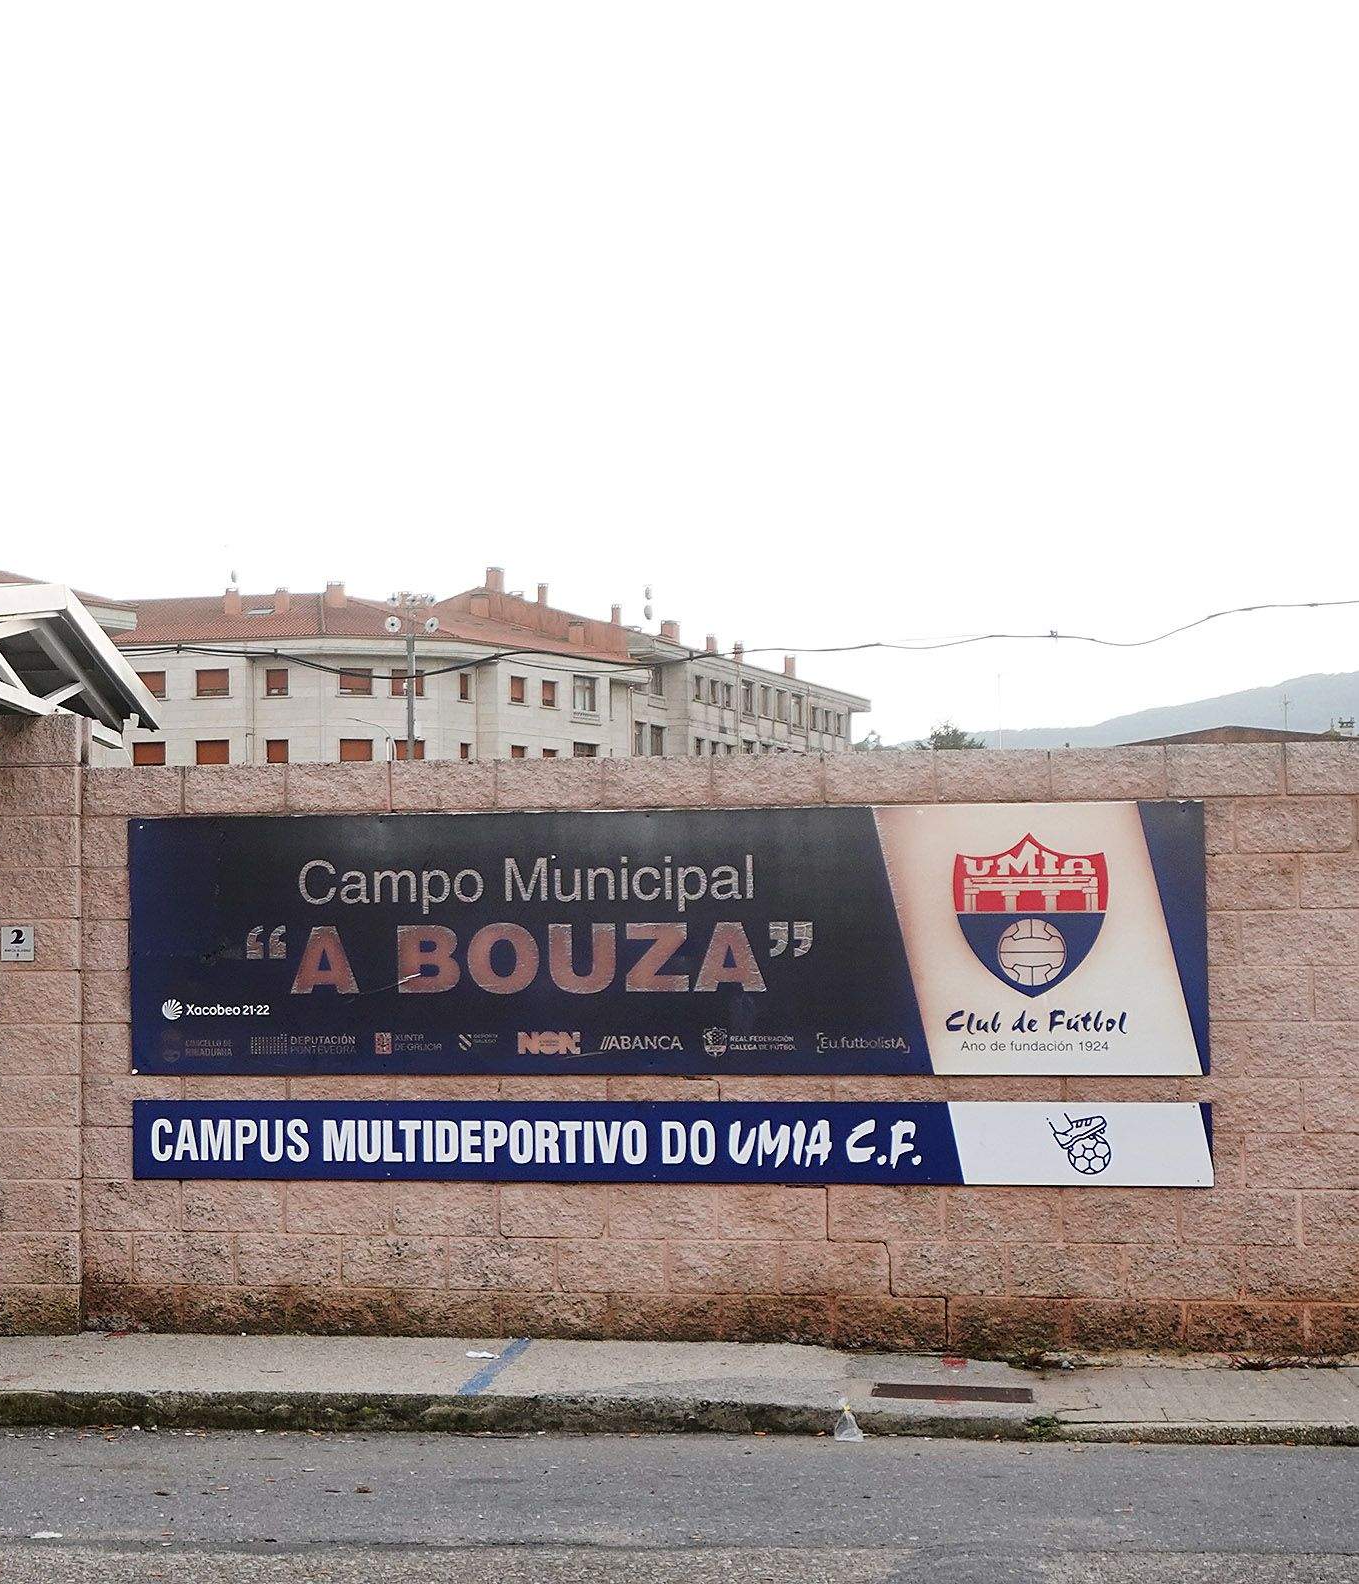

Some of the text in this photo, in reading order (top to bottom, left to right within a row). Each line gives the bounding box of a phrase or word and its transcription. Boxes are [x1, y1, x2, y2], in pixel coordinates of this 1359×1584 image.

[962, 843, 1096, 878] UMIA
[297, 854, 754, 914] Campo Municipal
[10, 929, 26, 945] 2
[186, 1004, 241, 1016] Xacobeo
[945, 1008, 1128, 1035] Club de Fútbol
[290, 1033, 356, 1045] DEPUTACIÓN
[394, 1033, 424, 1041] XUNTA
[407, 1043, 442, 1051] GALICIA
[960, 1040, 1110, 1053] Ano de fundación 1924
[150, 1118, 923, 1169] CAMPUS MULTIDEPORTIVO DO UMIA C.F.
